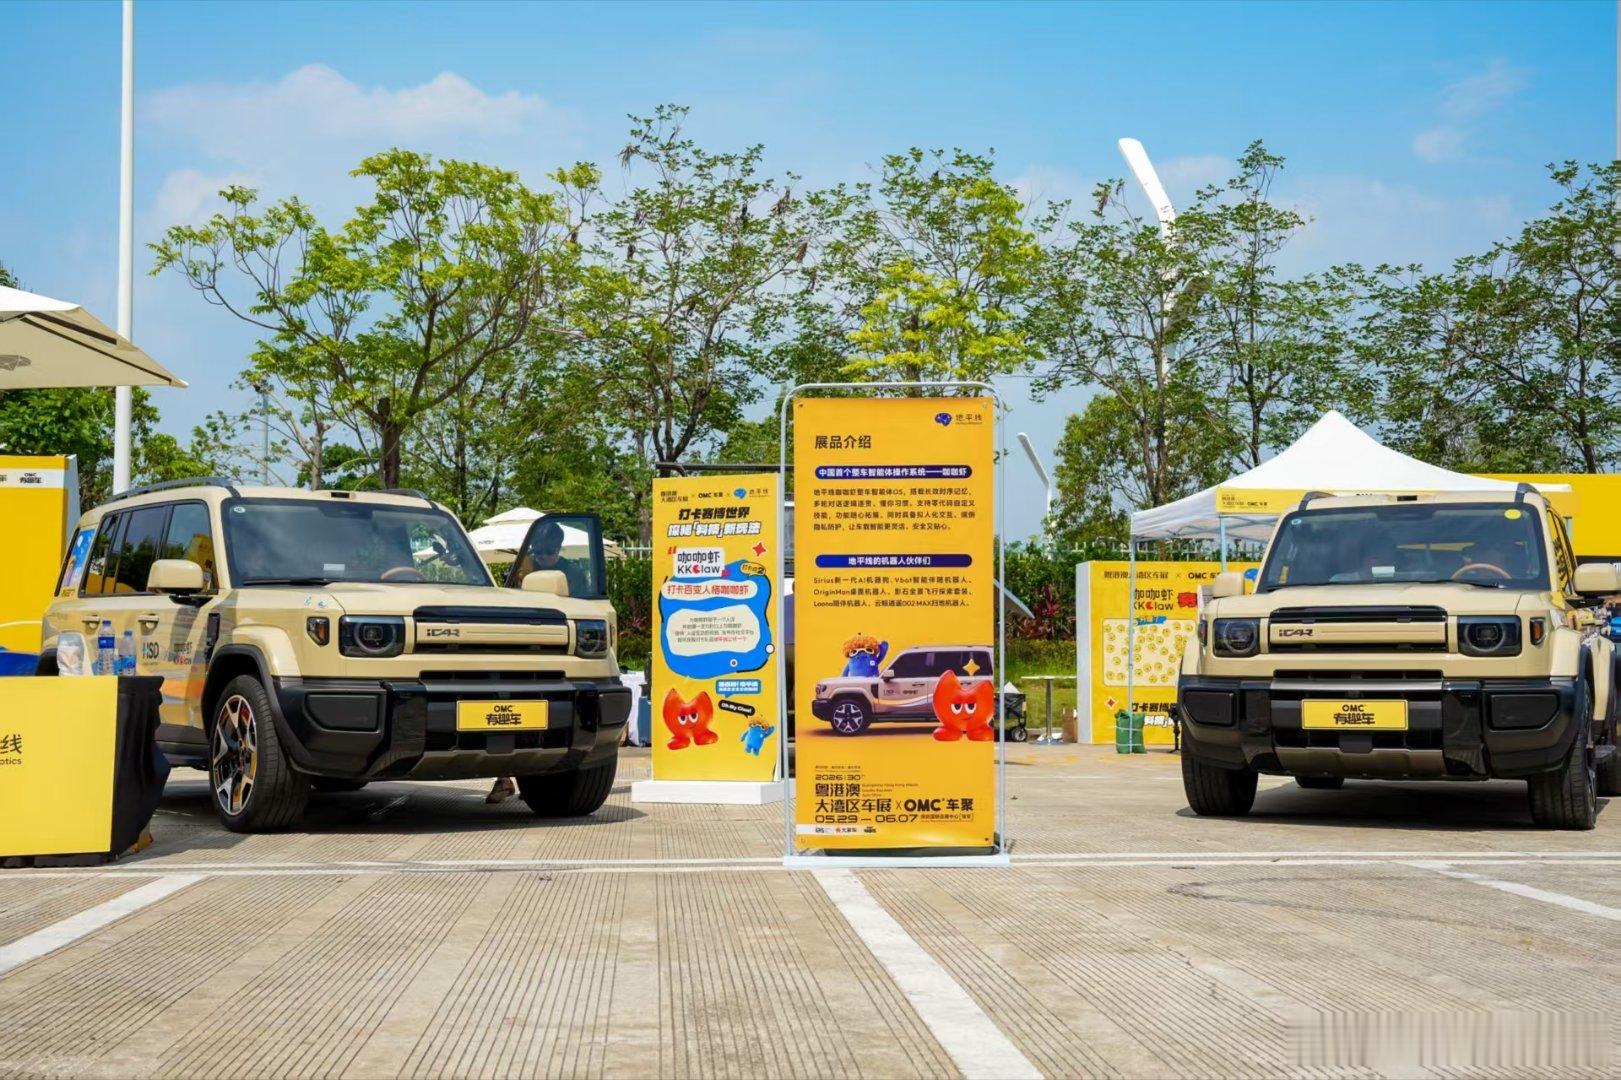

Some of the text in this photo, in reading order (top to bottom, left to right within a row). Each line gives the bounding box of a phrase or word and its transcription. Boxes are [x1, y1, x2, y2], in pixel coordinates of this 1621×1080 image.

[814, 435, 872, 449] 展品介绍
[818, 468, 967, 477] 中国首个整车智能体操作系统——咖咖虾
[678, 506, 750, 520] 打卡赛博世界
[677, 550, 720, 563] 咖咖虾
[848, 556, 931, 565] 地平线的机器人伙伴们
[1104, 571, 1168, 579] 粤港澳湾区车展
[815, 783, 860, 797] 粤港澳
[815, 799, 892, 812] 大湾区车展
[904, 799, 941, 811] OMC
[947, 798, 974, 811] 车聚
